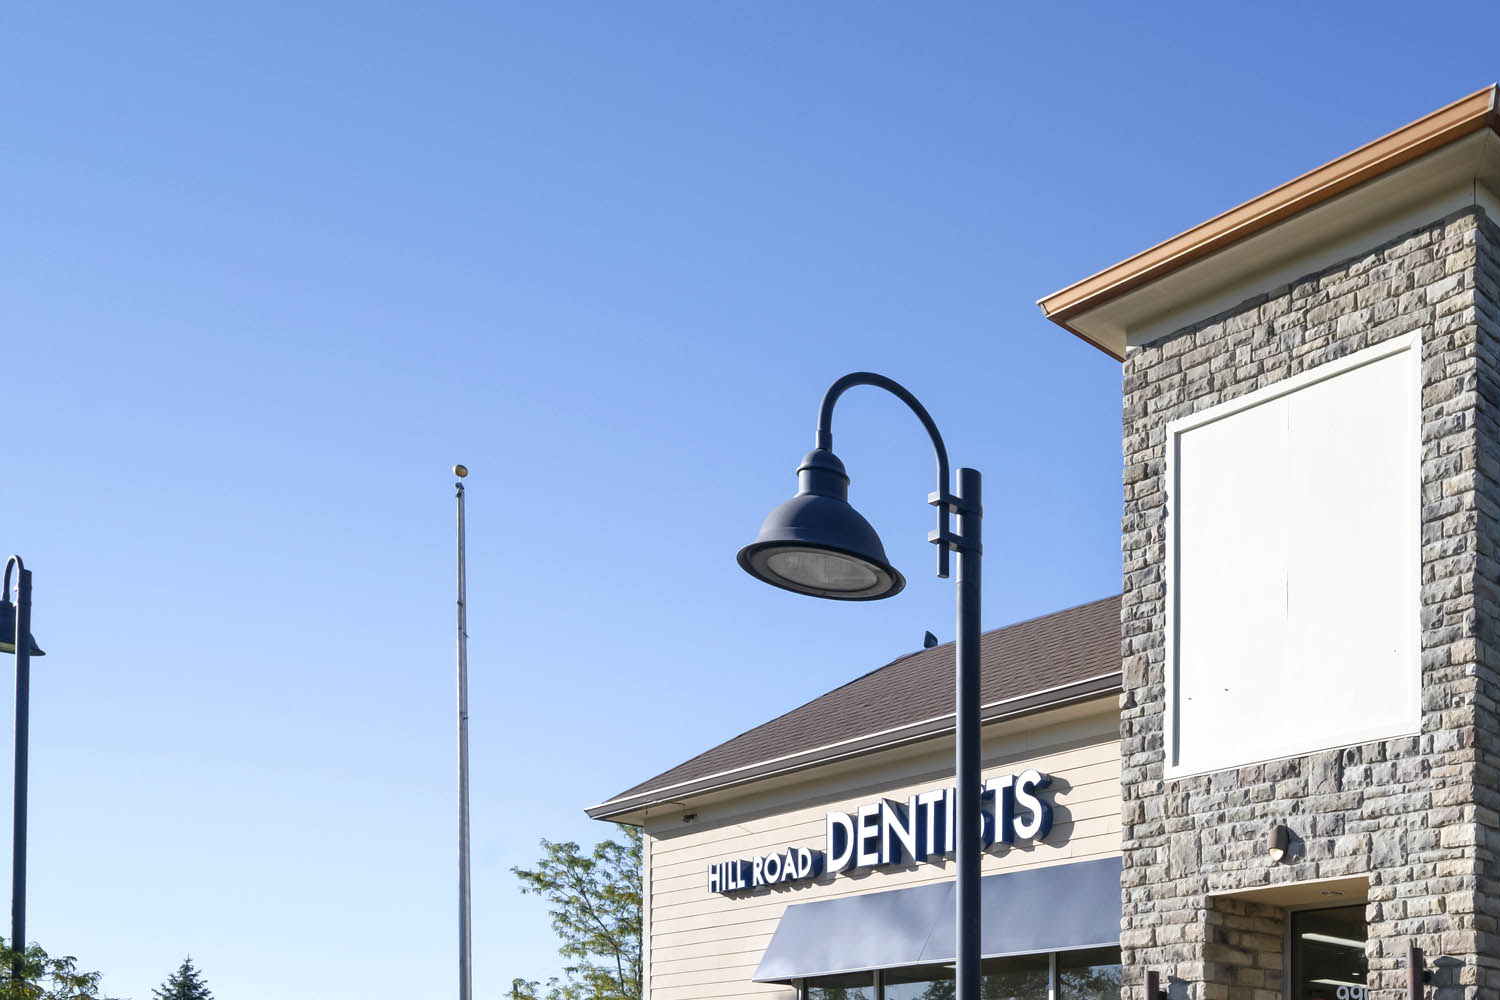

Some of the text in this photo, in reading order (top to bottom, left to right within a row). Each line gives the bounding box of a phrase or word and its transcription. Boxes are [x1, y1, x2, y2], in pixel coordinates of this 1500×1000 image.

[708, 768, 1044, 893] HILL ROAD DENTITS
